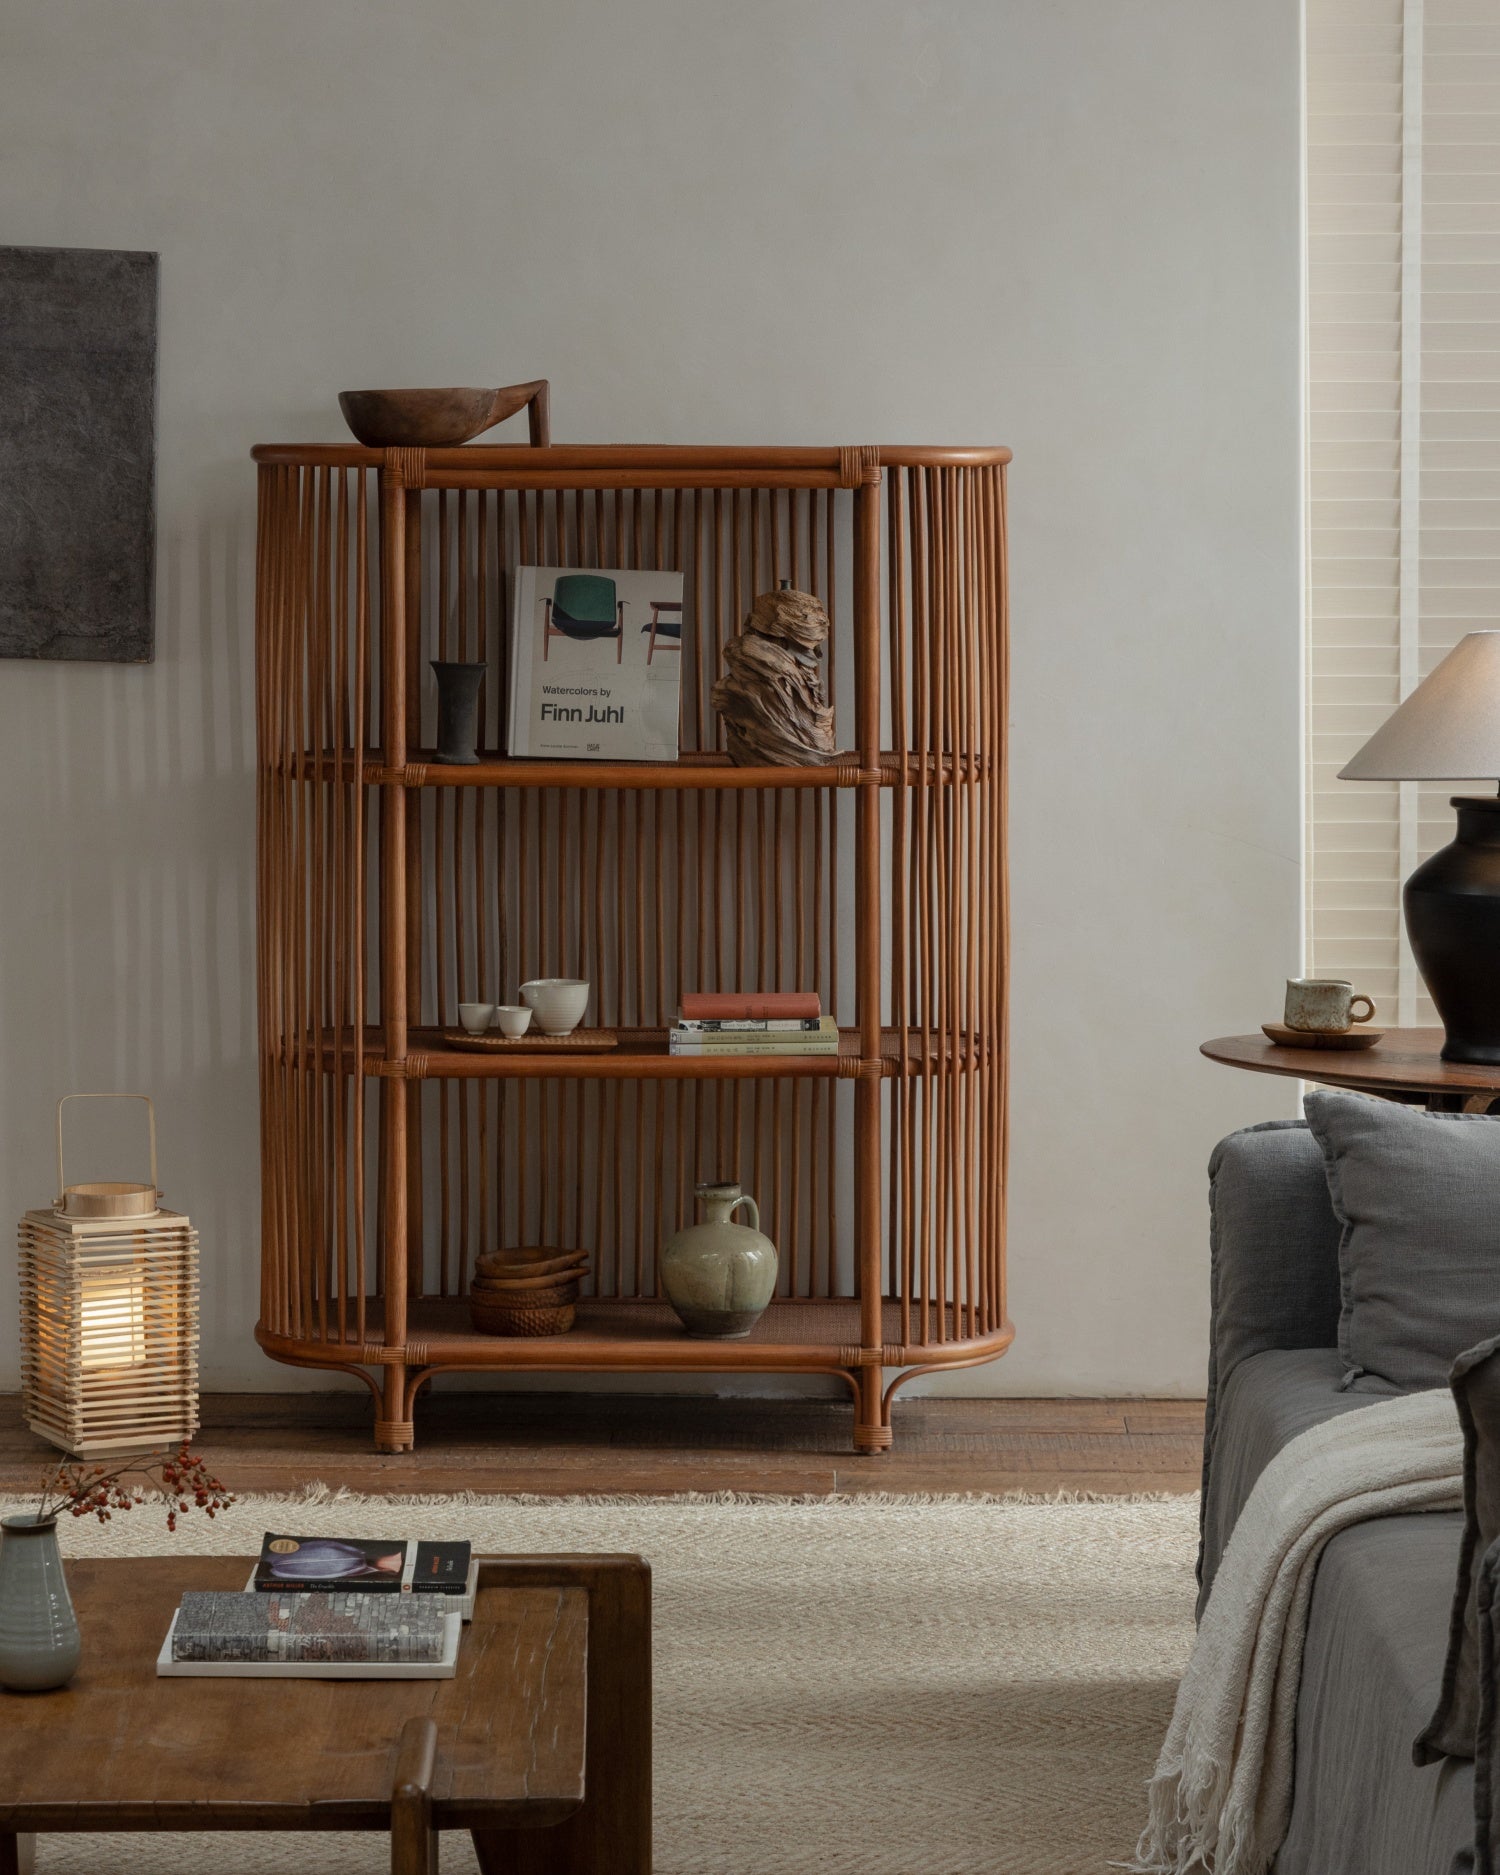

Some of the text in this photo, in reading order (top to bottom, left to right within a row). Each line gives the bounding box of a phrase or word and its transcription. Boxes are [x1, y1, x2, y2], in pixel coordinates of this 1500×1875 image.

[542, 686, 611, 698] Watercolors by
[541, 704, 624, 723] Finn Juhl
